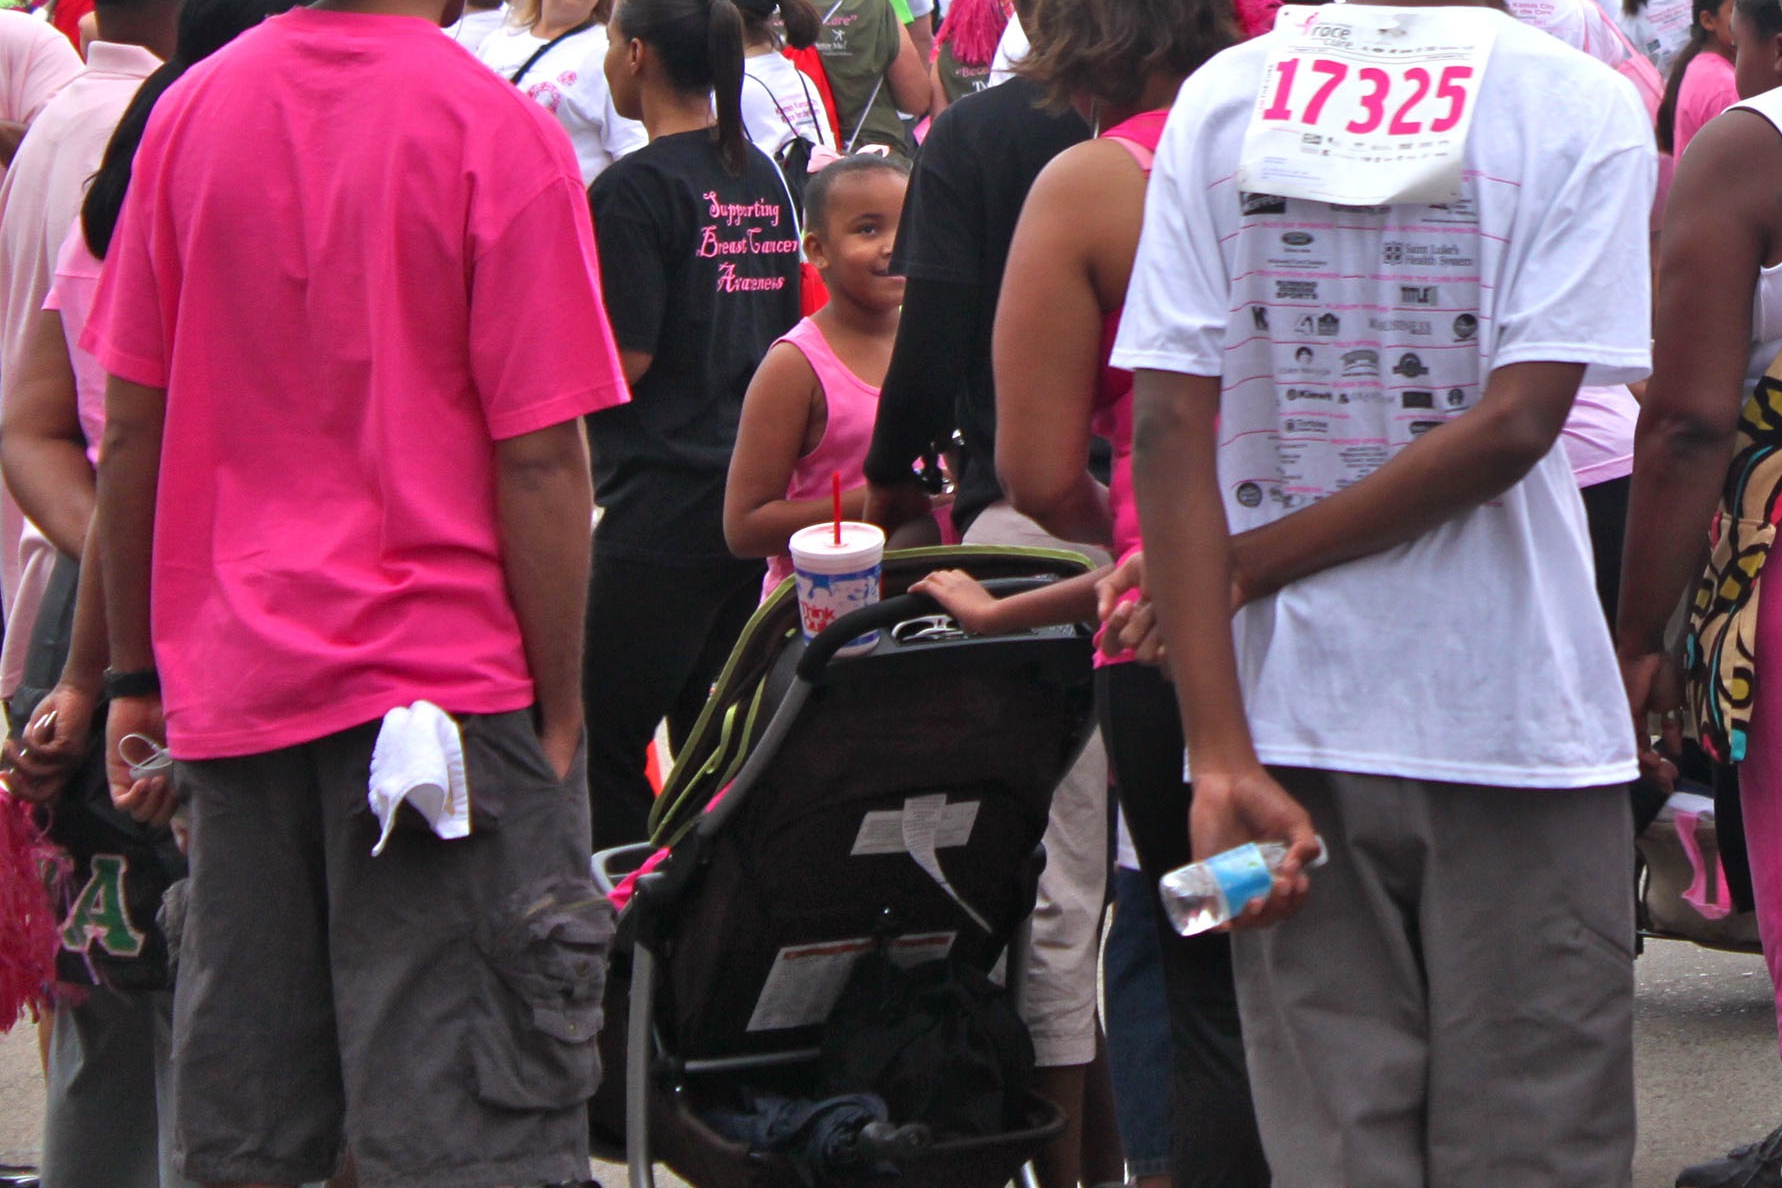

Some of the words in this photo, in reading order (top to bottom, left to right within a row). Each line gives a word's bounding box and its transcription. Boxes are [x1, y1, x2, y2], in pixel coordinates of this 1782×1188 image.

[1311, 24, 1352, 40] race
[1262, 57, 1475, 136] 17325
[702, 190, 780, 227] Supporting
[696, 224, 747, 259] Breast
[746, 227, 799, 254] Cancer
